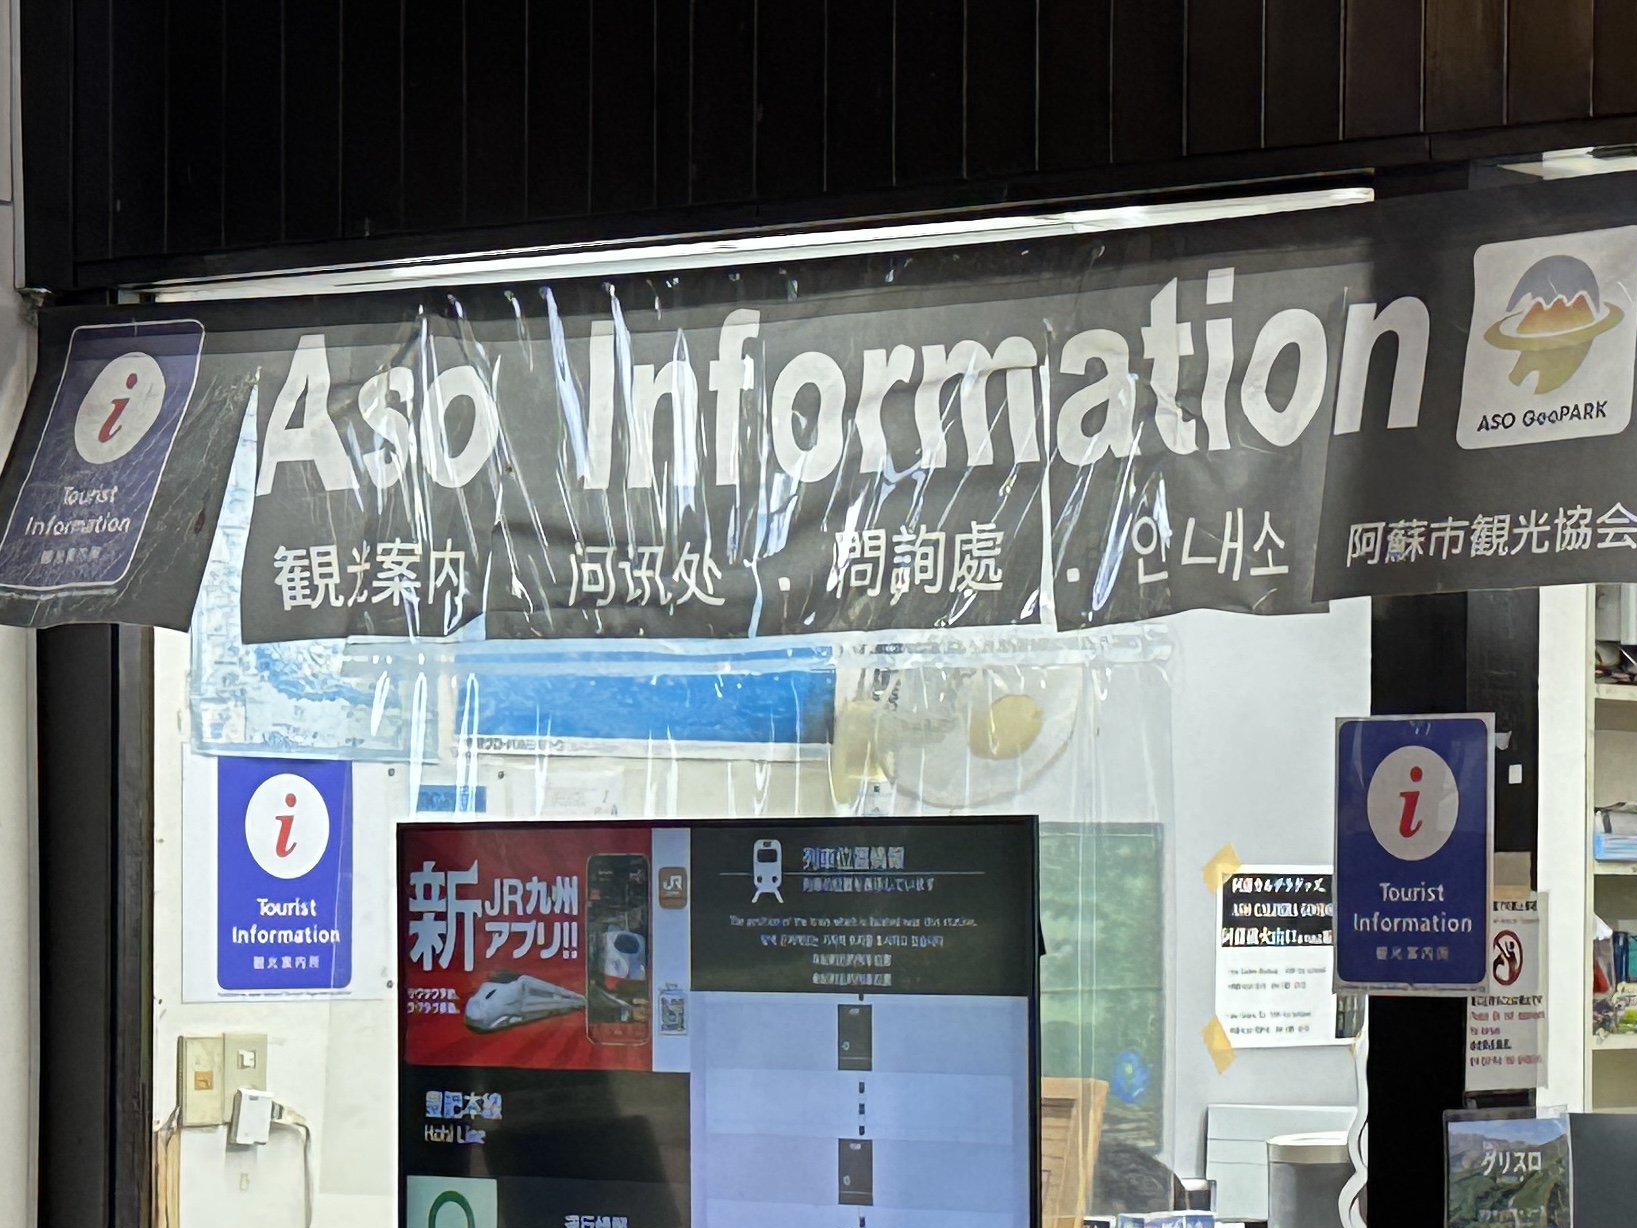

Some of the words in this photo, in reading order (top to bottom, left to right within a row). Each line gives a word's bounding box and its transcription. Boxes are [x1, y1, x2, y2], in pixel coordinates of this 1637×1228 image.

[256, 334, 499, 496] Aso
[584, 268, 1429, 490] Information
[1477, 412, 1515, 432] ASO
[63, 483, 118, 505] Tourist
[24, 512, 131, 537] Information
[1130, 507, 1290, 585] 안내소
[568, 541, 726, 608] 问讯处
[485, 875, 578, 916] JR九州
[1379, 881, 1444, 902] Tourist
[256, 898, 317, 917] Tourist
[409, 859, 482, 972] 新
[232, 924, 341, 944] Information
[1353, 912, 1473, 933] Information
[485, 920, 578, 960] アプリ!!
